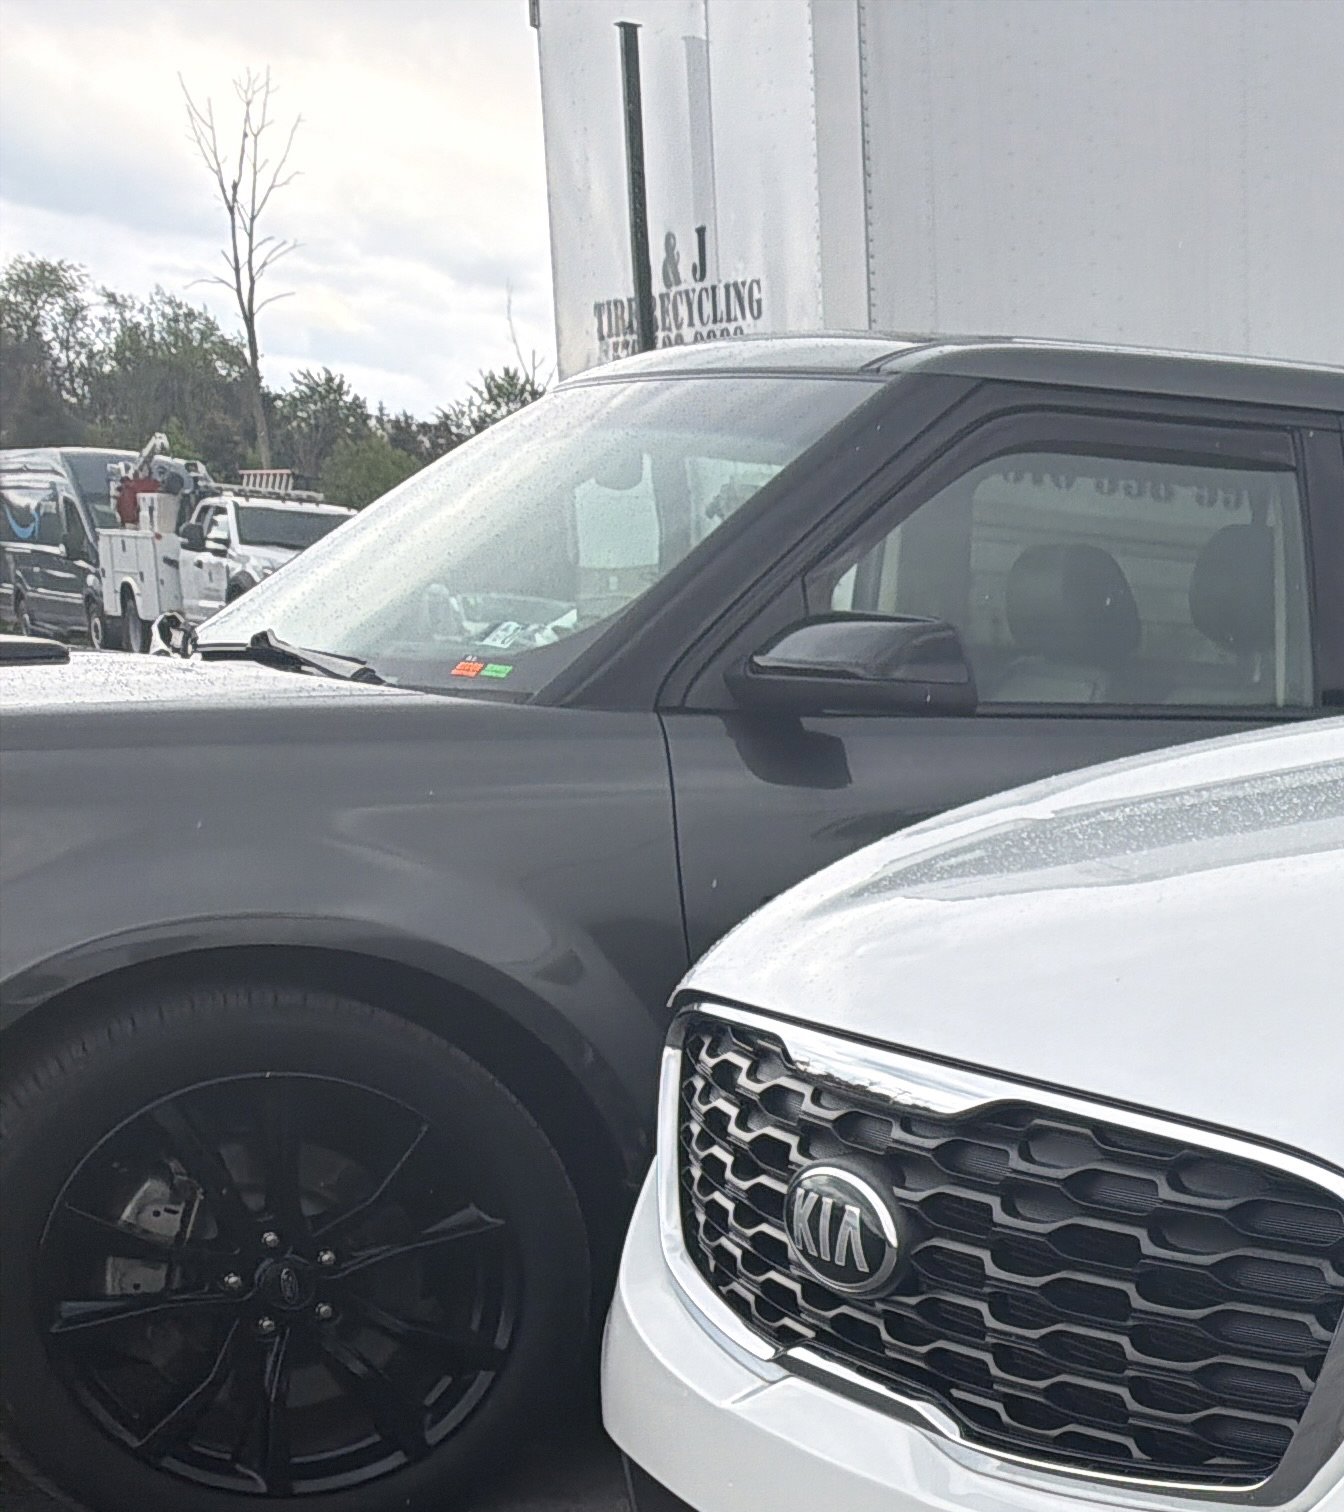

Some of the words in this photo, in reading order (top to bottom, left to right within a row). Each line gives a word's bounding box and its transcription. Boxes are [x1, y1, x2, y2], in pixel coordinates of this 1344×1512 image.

[662, 231, 682, 289] &
[691, 224, 707, 283] J
[793, 1186, 870, 1273] KIA
